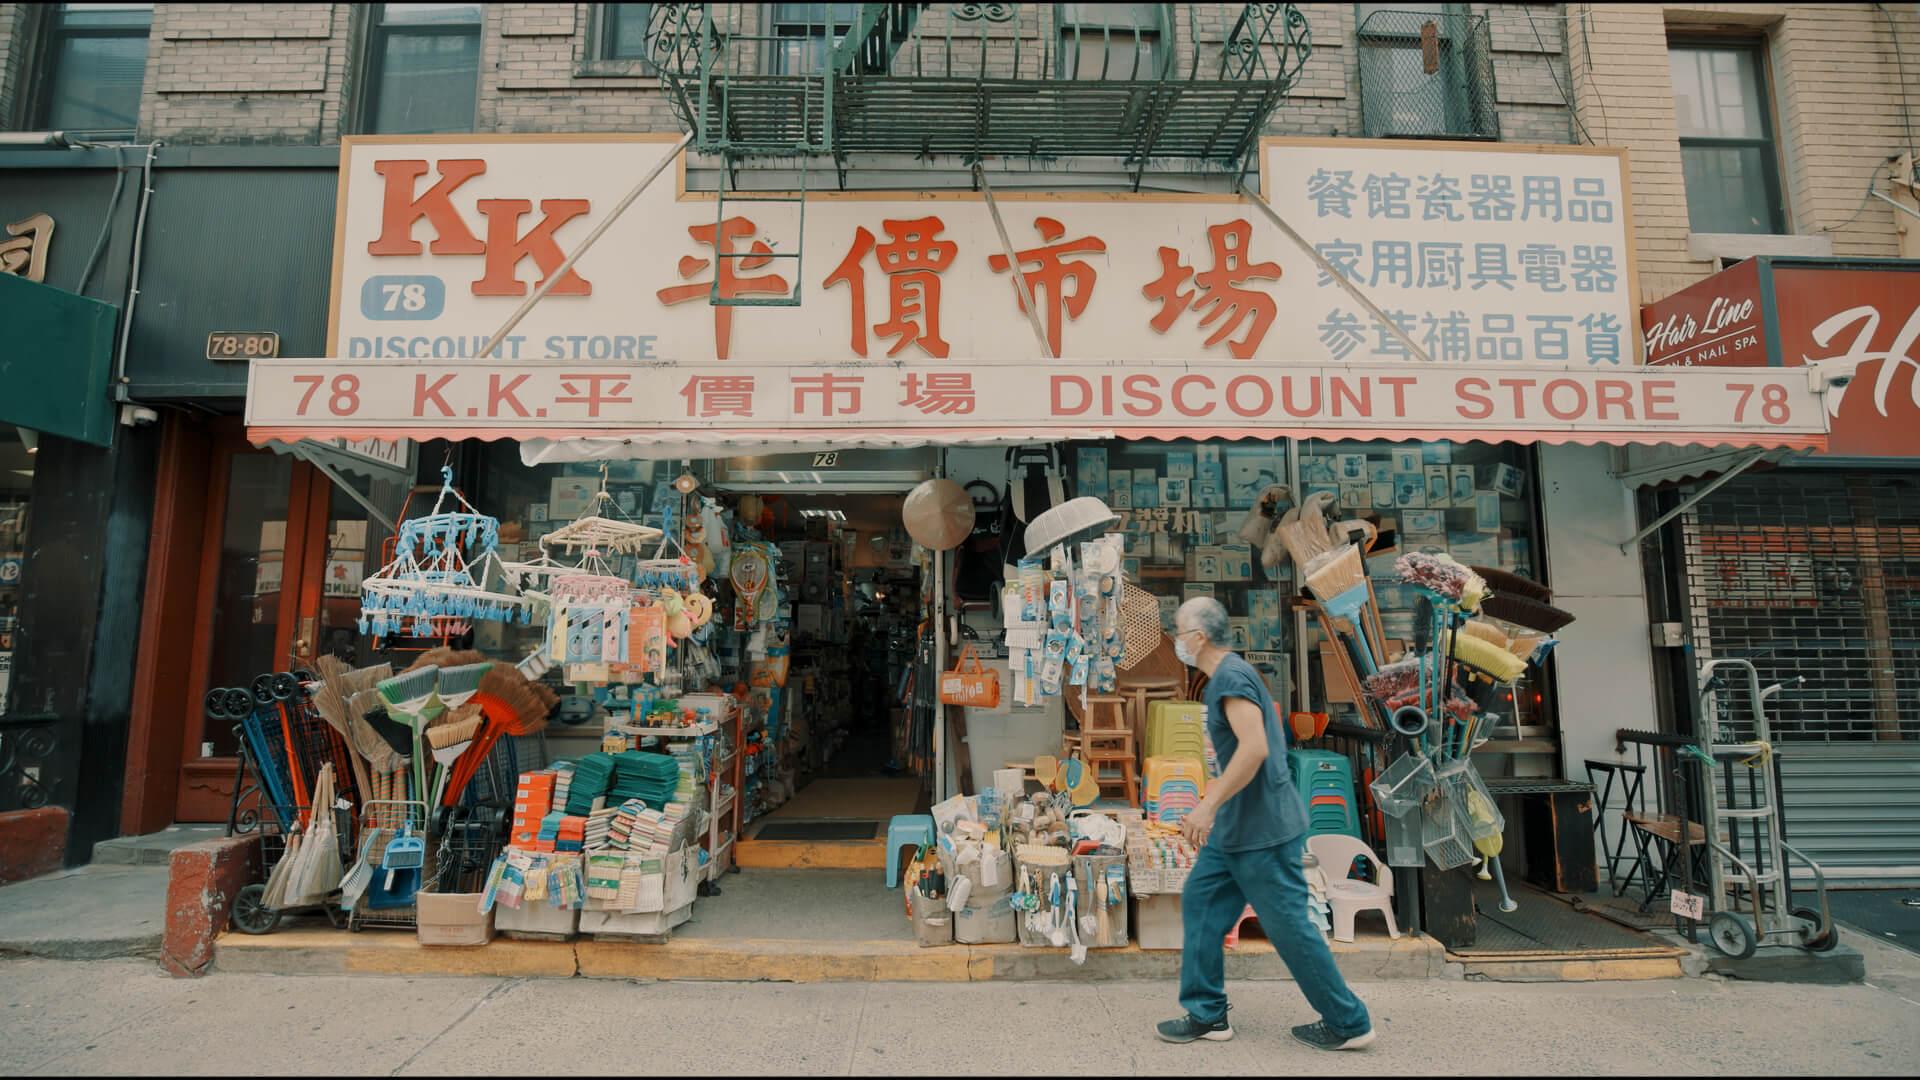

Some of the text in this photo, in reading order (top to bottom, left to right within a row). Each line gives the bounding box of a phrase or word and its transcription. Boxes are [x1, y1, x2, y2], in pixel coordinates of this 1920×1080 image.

[1307, 167, 1614, 223] 餐館瓷器用品
[368, 159, 592, 296] KK
[382, 284, 426, 311] 78
[656, 215, 1281, 359] 平價市場
[211, 336, 274, 355] 78-80
[350, 335, 658, 359] DISCOUNT STORE
[1646, 296, 1754, 356] Hair Line
[1698, 344, 1728, 362] NAIL
[1735, 335, 1757, 351] SPA
[1803, 304, 1920, 419] H
[293, 373, 360, 417] 78
[1050, 373, 1418, 418] DISCOUNT
[1454, 377, 1680, 421] STORE
[1725, 383, 1791, 425] 78
[815, 453, 836, 465] 78
